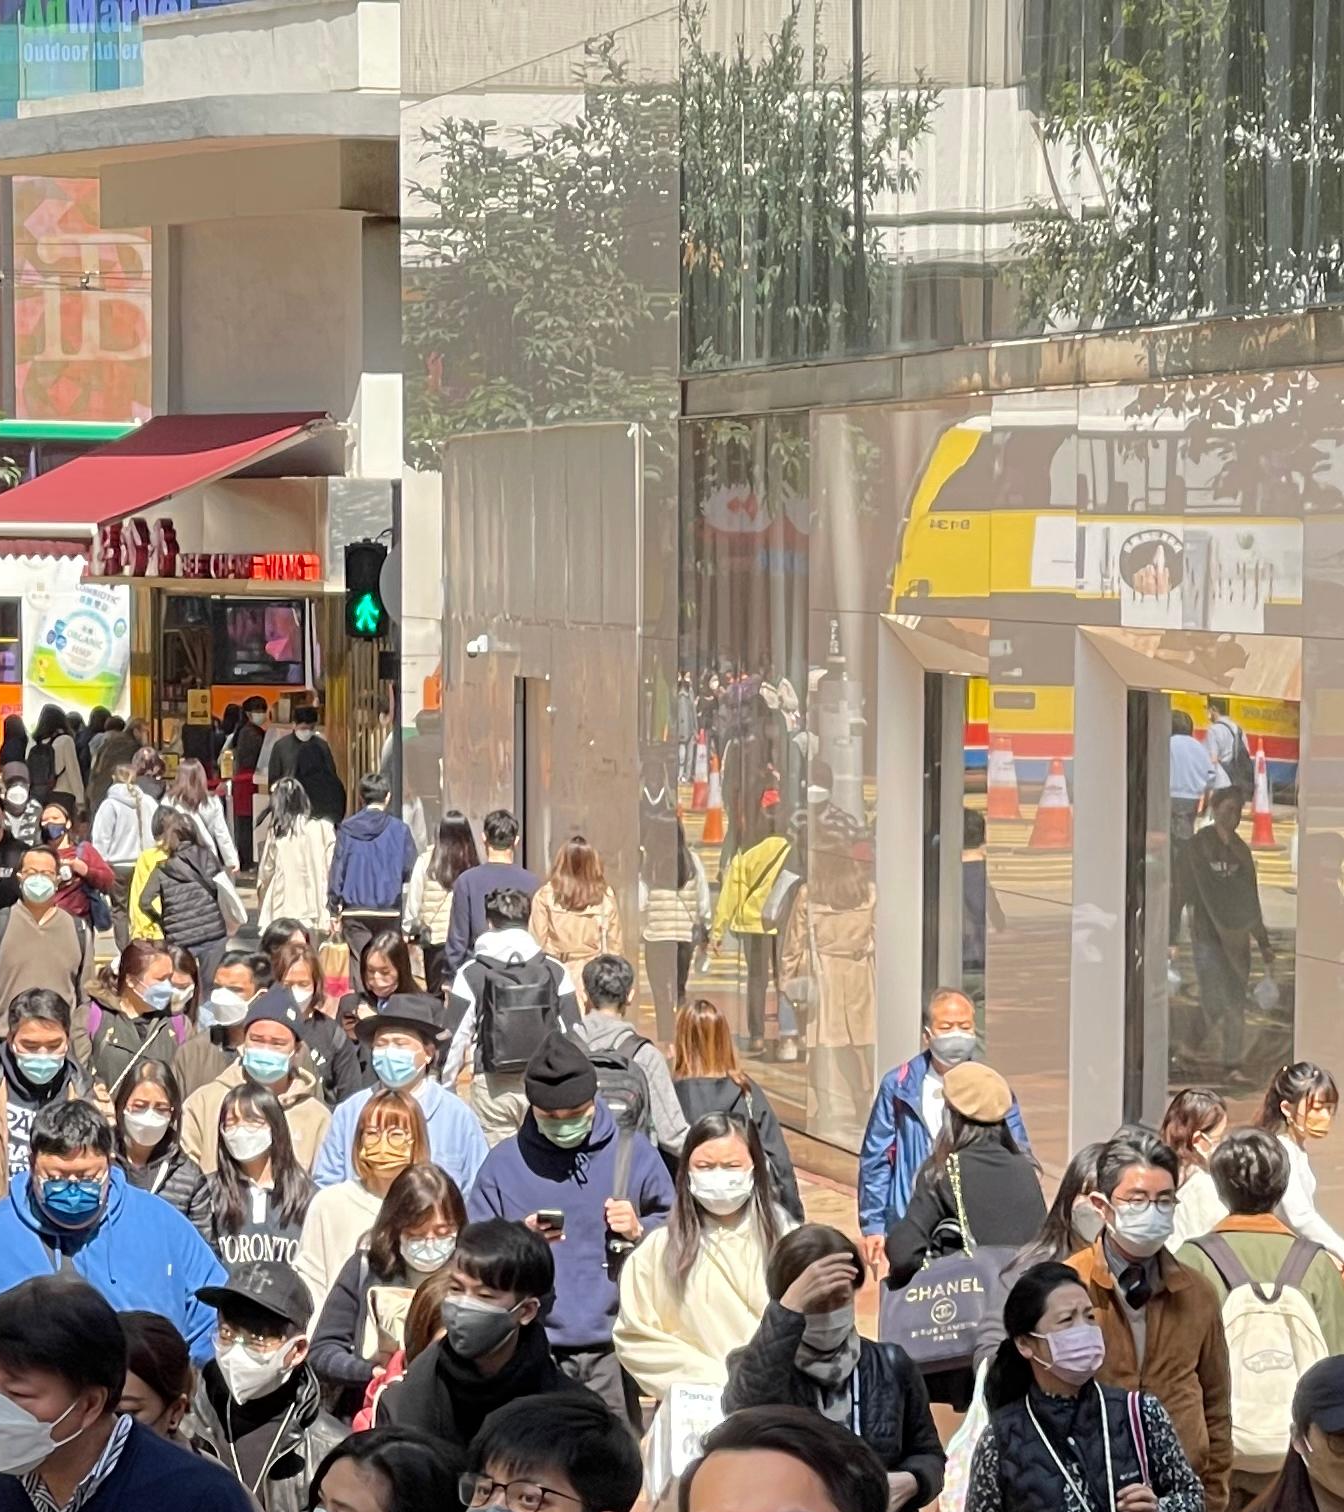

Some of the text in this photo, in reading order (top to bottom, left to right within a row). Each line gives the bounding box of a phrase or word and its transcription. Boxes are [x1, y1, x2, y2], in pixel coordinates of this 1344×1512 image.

[23, 41, 144, 64] Outdoor Adver
[905, 1277, 985, 1302] CHANEL
[679, 1389, 714, 1402] Pana
